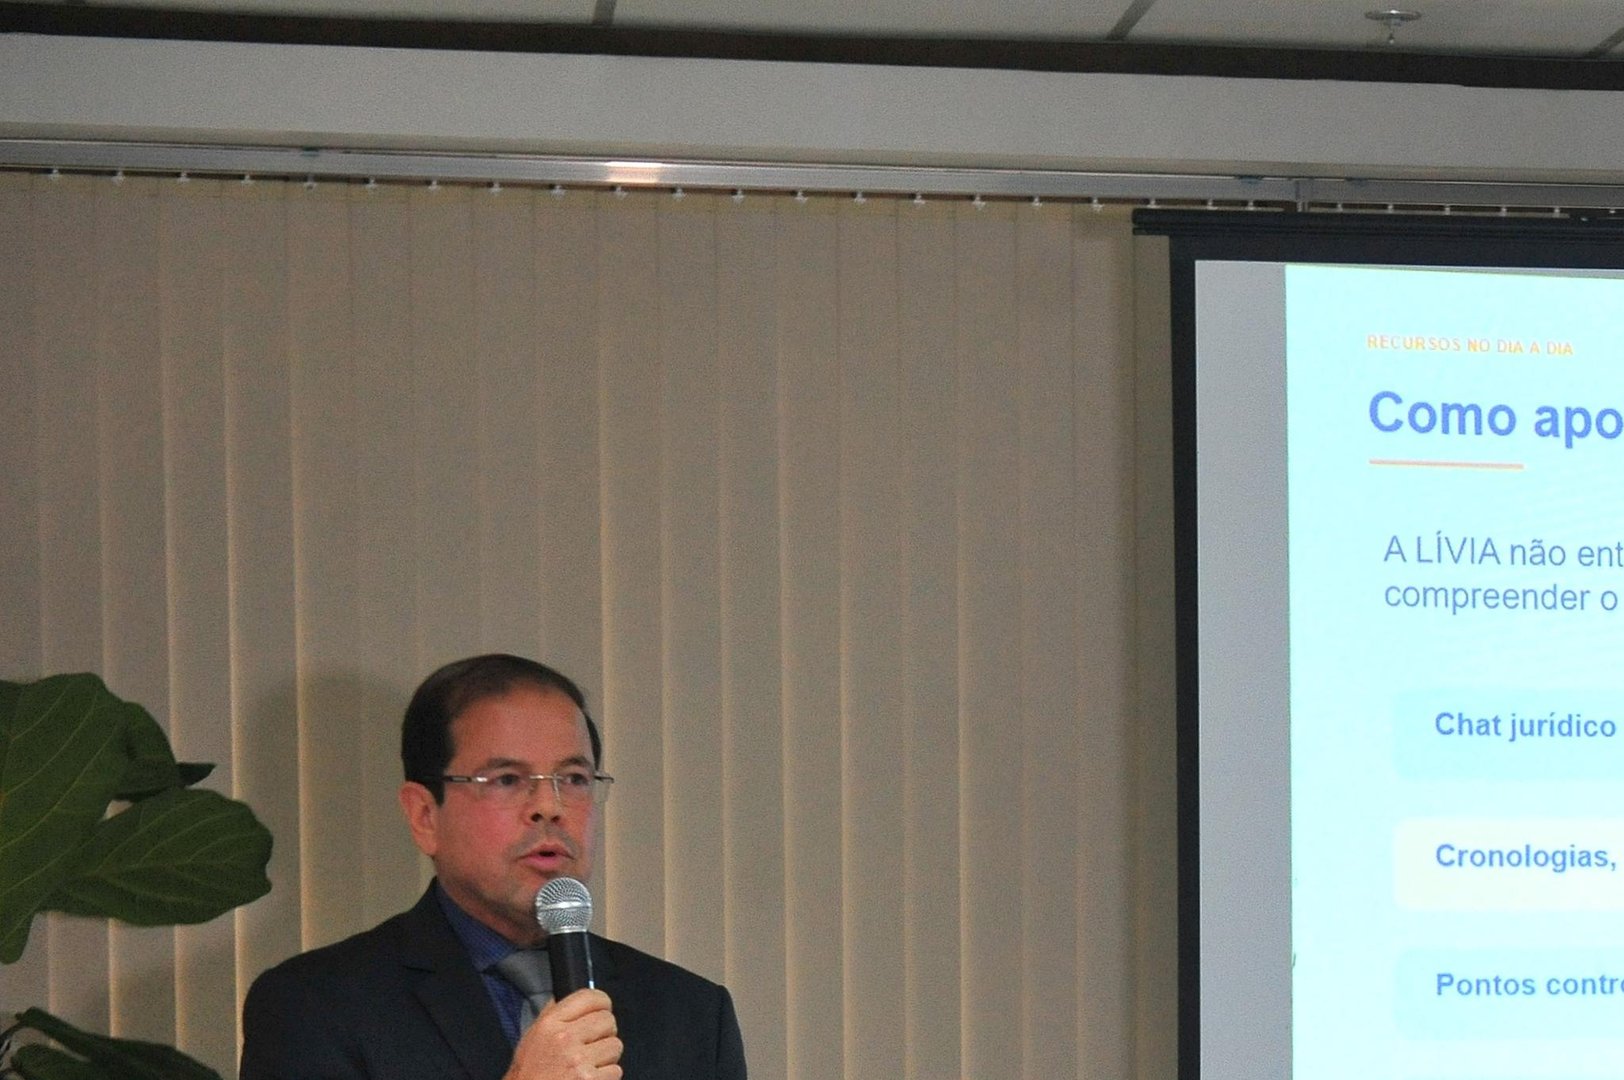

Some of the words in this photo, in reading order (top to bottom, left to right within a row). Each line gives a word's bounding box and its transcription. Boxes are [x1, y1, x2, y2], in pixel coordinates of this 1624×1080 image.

[1367, 335, 1461, 352] RECURSOS
[1467, 339, 1490, 352] NO
[1497, 340, 1523, 353] DIA
[1529, 342, 1540, 353] A
[1547, 342, 1573, 355] DIA
[1368, 391, 1515, 436] Como
[1383, 536, 1407, 563] A
[1416, 531, 1501, 565] LÍVIA
[1510, 537, 1567, 567] não
[1384, 582, 1591, 618] compreender
[1600, 589, 1618, 612] o
[1434, 712, 1502, 739] Chat
[1509, 712, 1616, 742] jurídico
[1435, 843, 1617, 874] Cronologias,
[1436, 972, 1537, 998] Pontos
